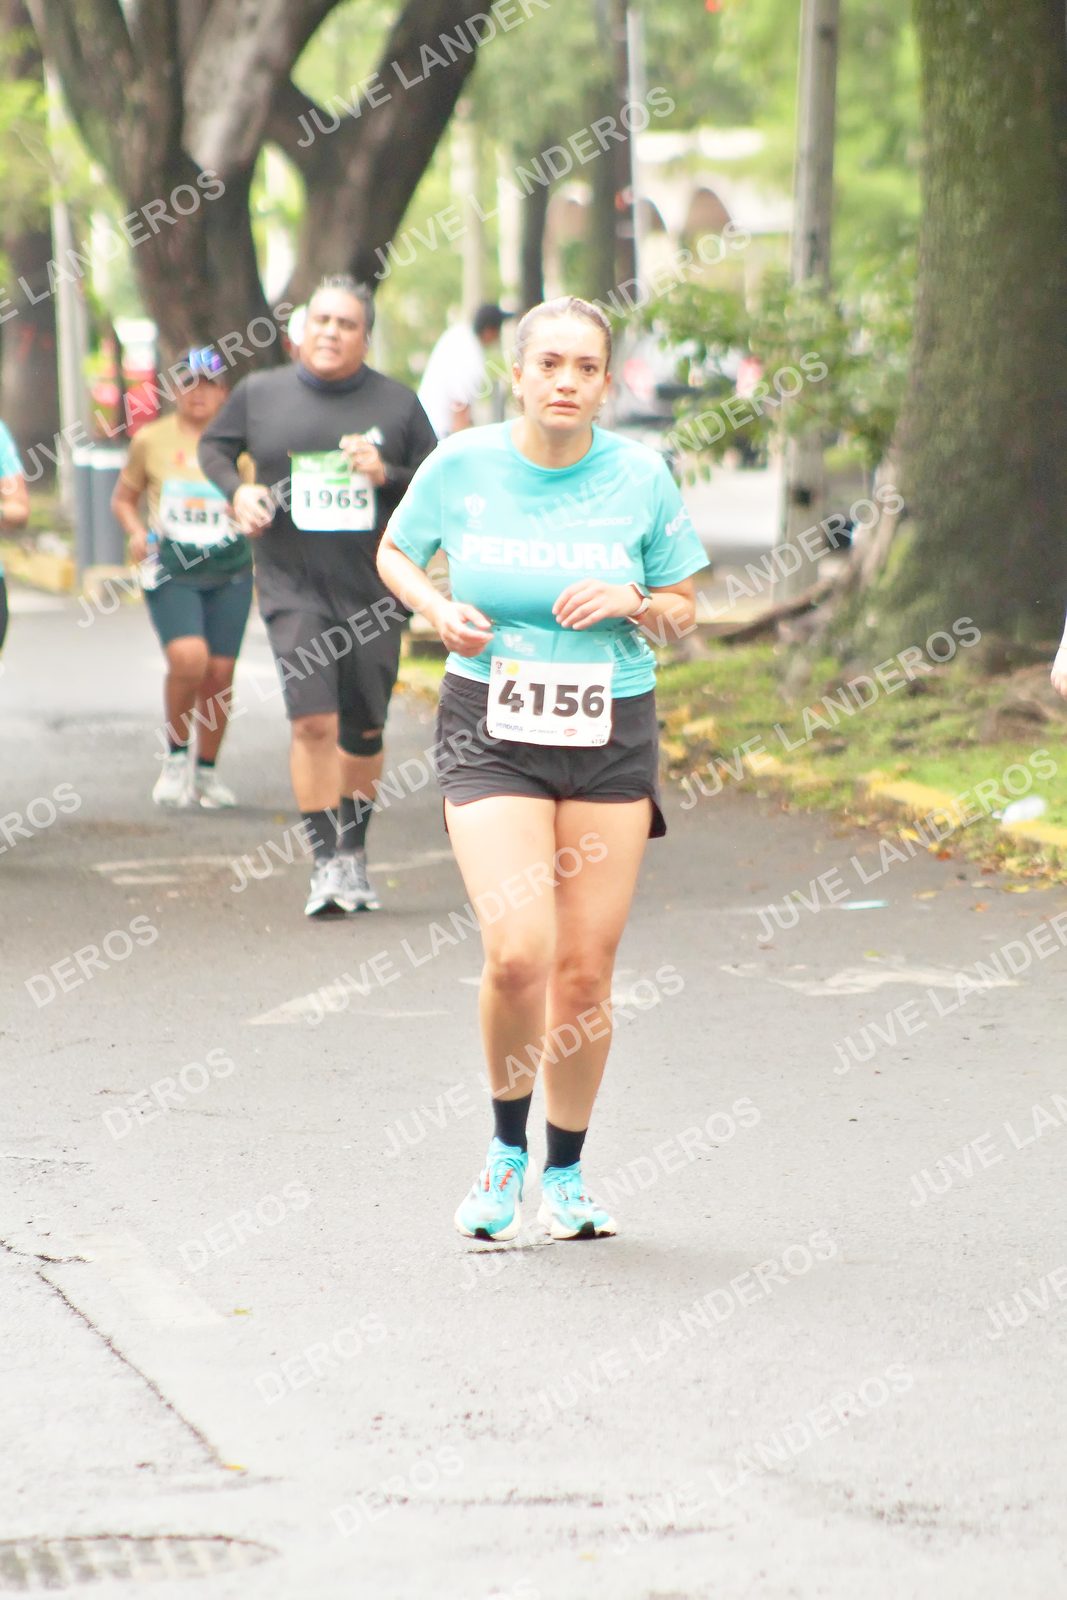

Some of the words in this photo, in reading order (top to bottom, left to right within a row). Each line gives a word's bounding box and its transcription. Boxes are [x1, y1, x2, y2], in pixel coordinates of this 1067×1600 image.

[304, 489, 369, 510] 1965
[461, 533, 633, 571] PERDURA
[498, 679, 606, 719] 4156
